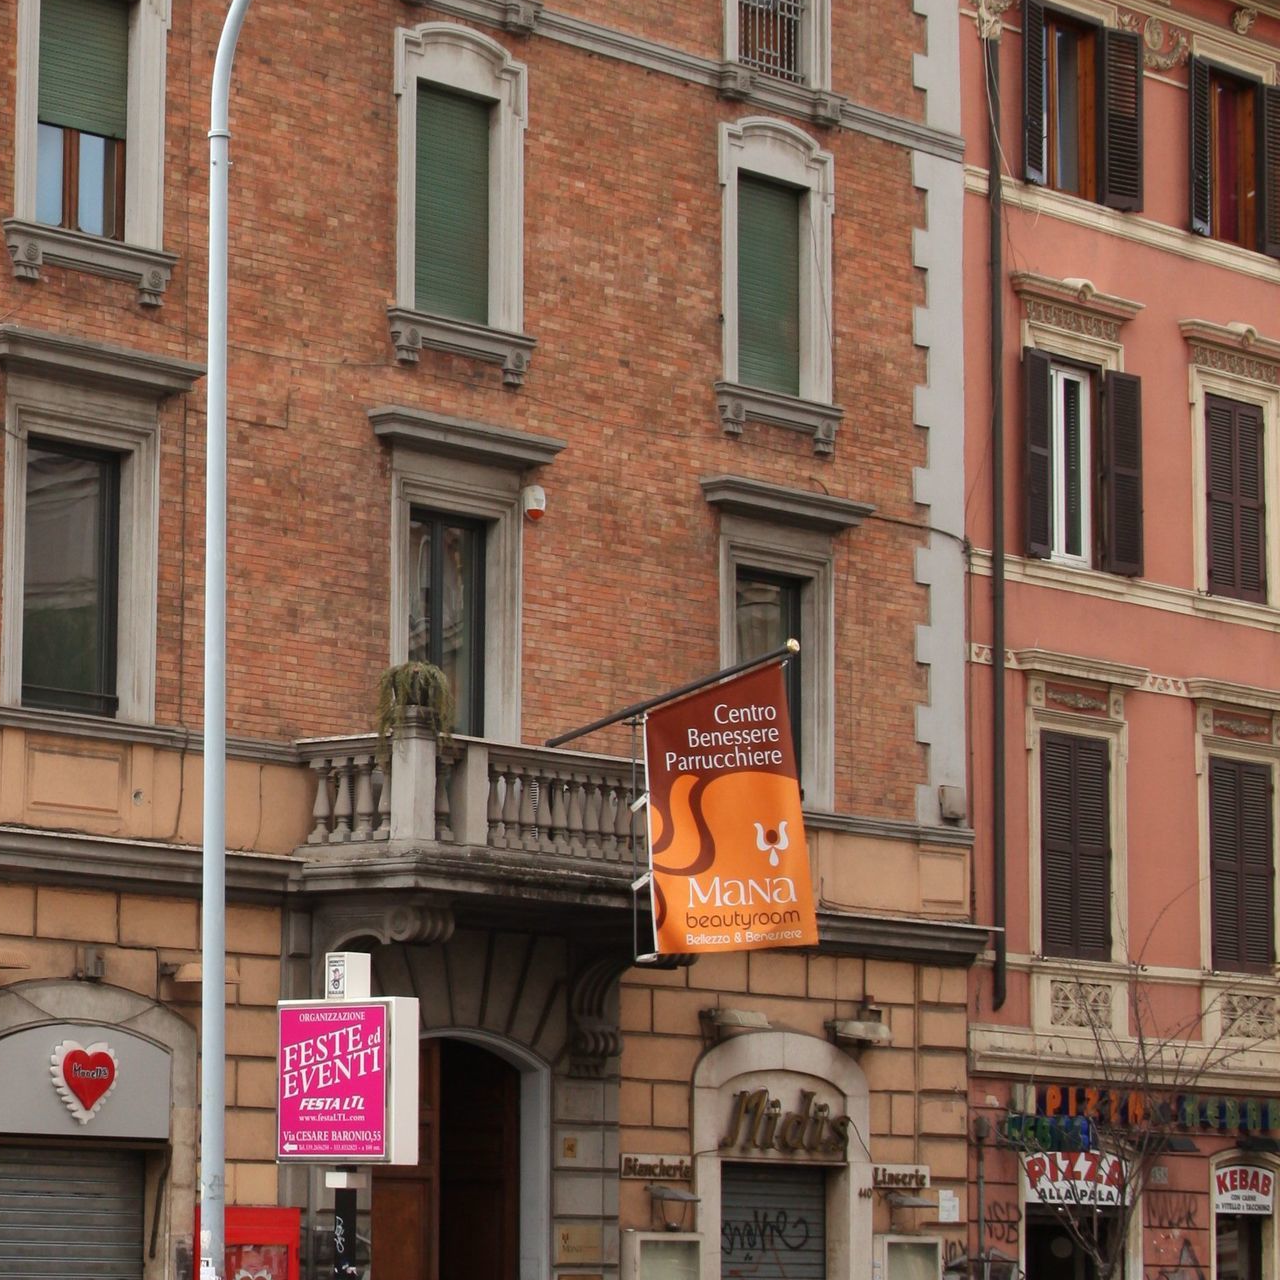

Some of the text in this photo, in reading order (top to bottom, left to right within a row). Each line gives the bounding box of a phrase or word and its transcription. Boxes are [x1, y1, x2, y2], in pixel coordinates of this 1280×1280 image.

[714, 704, 776, 724] Centro
[688, 727, 780, 748] Benessere
[666, 747, 783, 771] Parrucchiere
[686, 909, 801, 930] beautyroom
[686, 929, 803, 946] Bellezza & Benessere
[299, 1011, 365, 1022] ORGANIZZAZIONE
[283, 1024, 381, 1072] FESTE ed
[283, 1046, 381, 1099] EVENTI
[299, 1095, 365, 1111] FESTA LTL
[296, 1130, 329, 1141] CESARE
[1026, 1151, 1124, 1189] PIZZA
[1216, 1169, 1273, 1197] KEBAB
[1039, 1188, 1115, 1202] ALLA PALA
